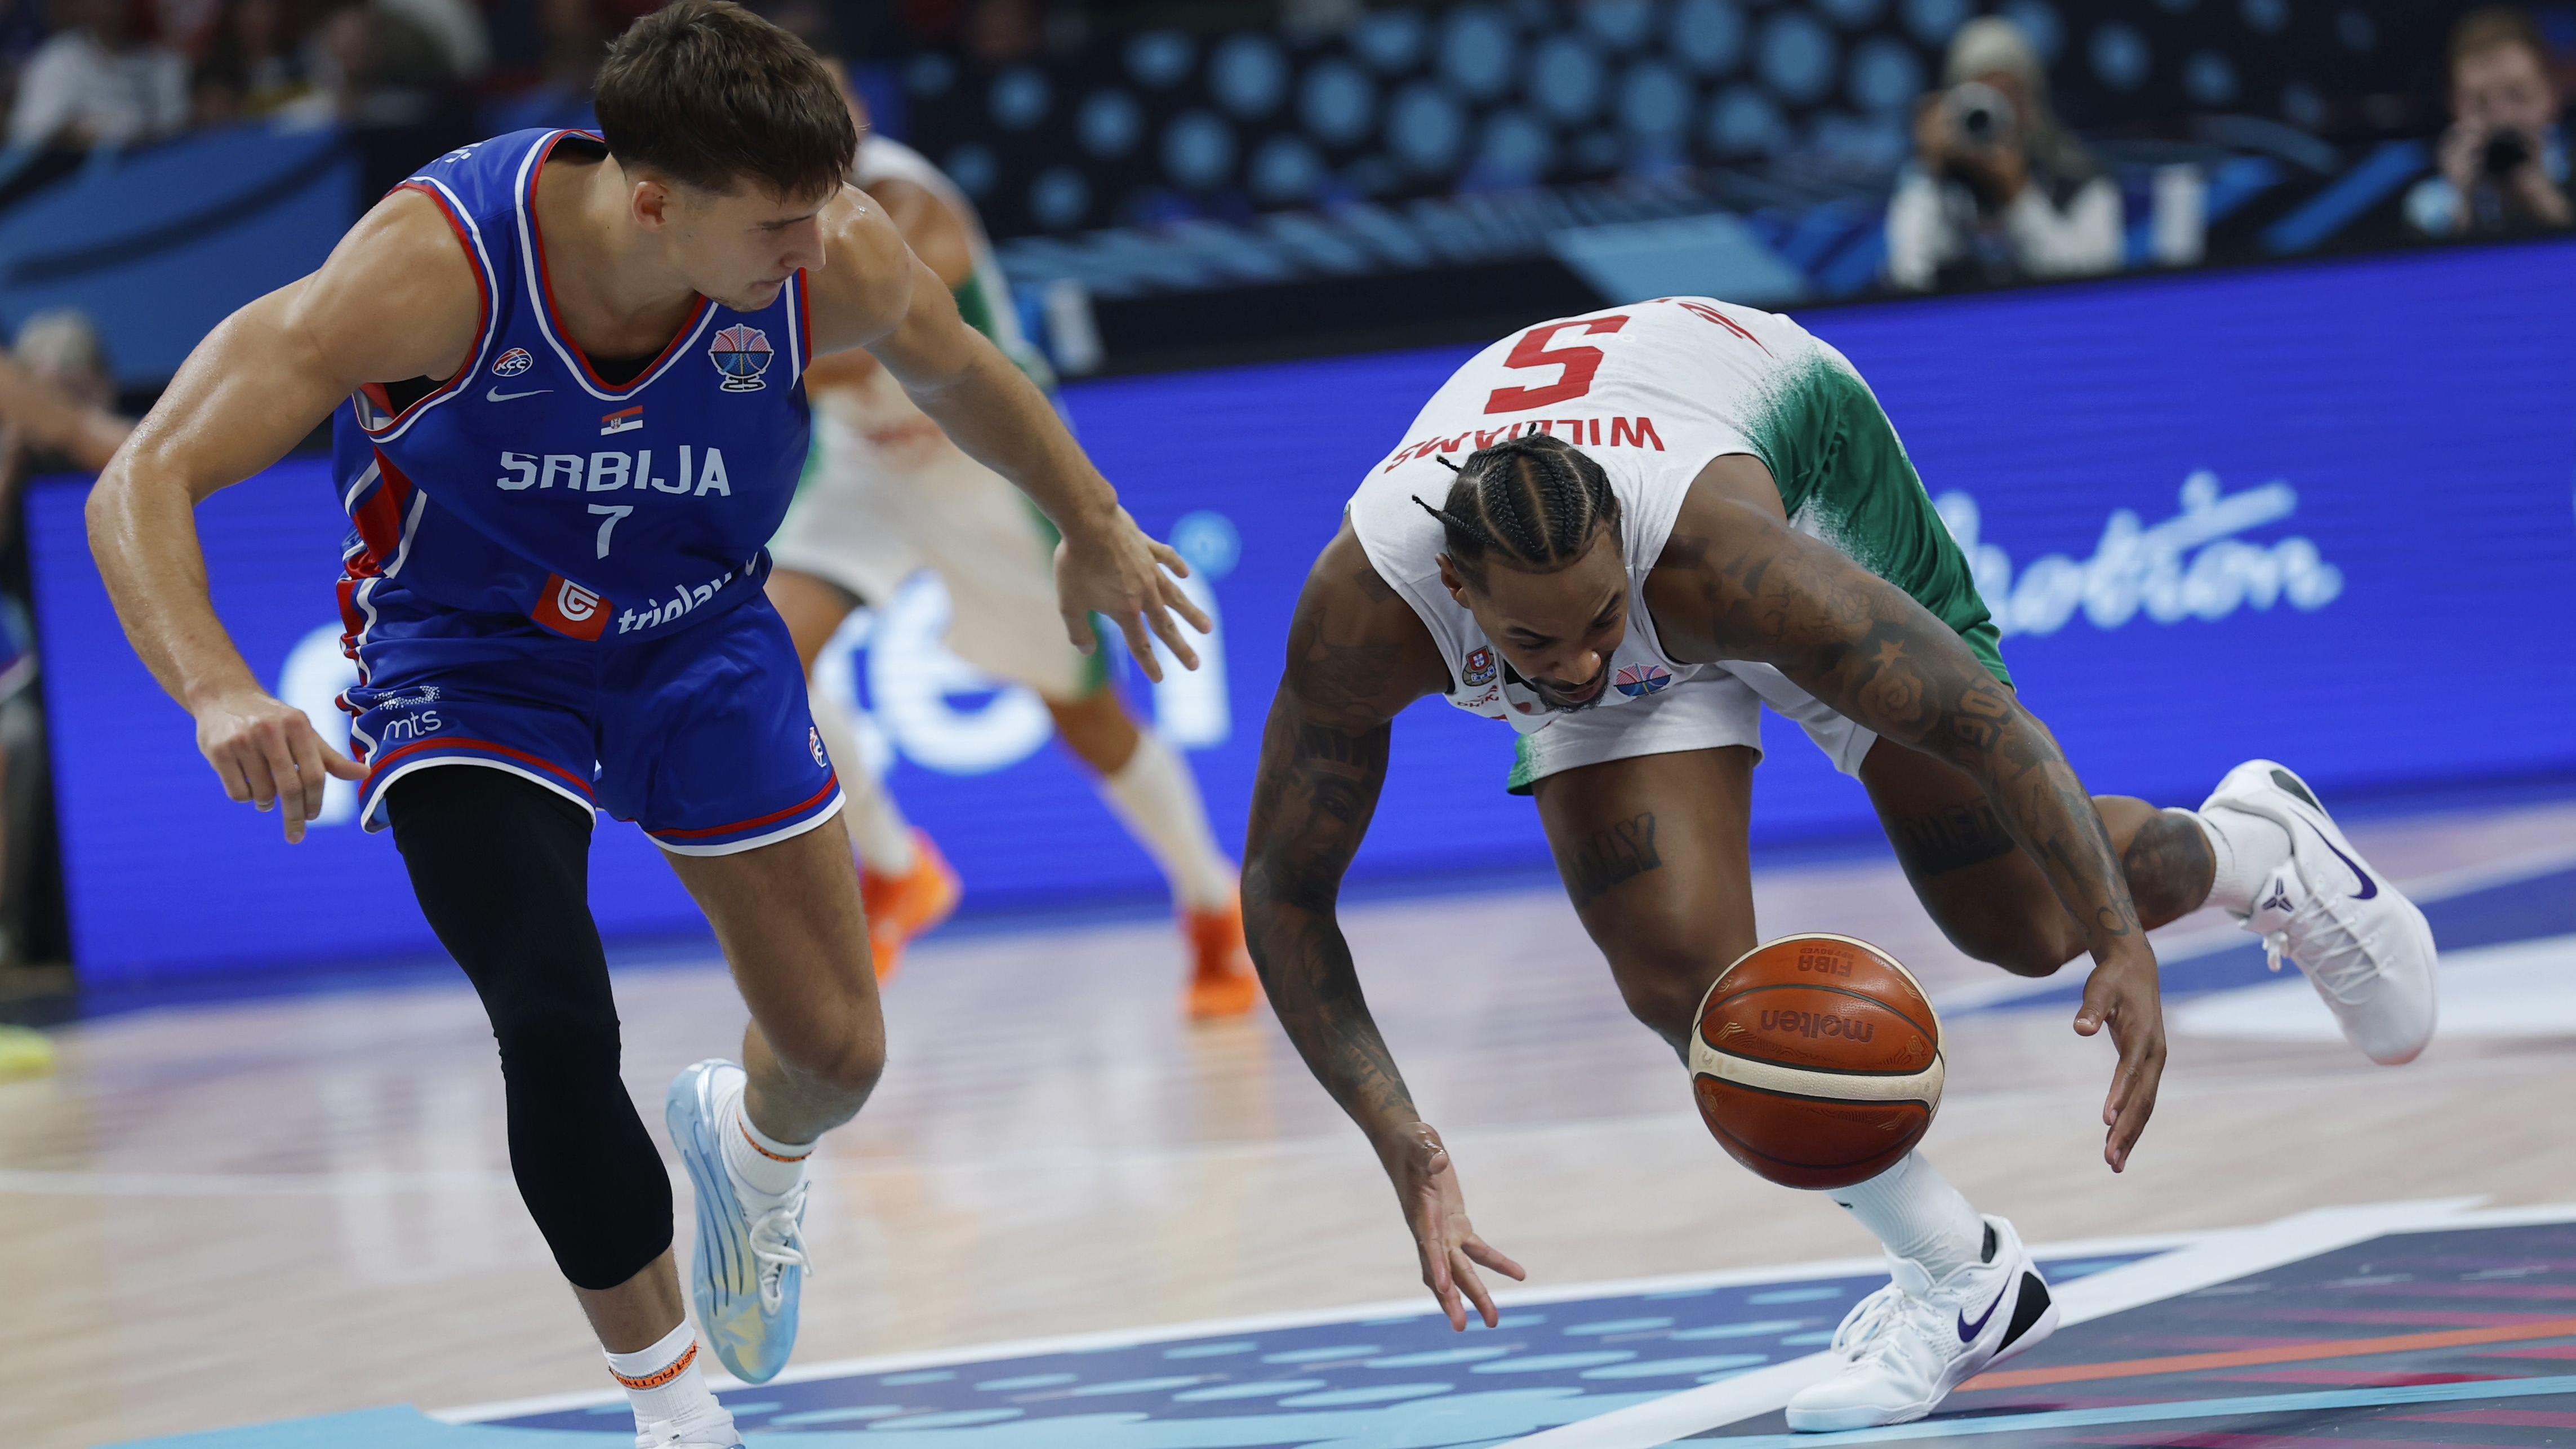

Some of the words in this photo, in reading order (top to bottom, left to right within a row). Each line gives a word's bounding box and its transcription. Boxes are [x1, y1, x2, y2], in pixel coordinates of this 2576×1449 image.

[495, 360, 527, 371] KCC
[1484, 315, 1630, 414] 5
[496, 445, 732, 497] SRBIJA
[587, 504, 634, 560] 7
[383, 710, 442, 741] mts
[1797, 954, 1853, 977] FIBA
[1760, 1009, 1875, 1044] molten
